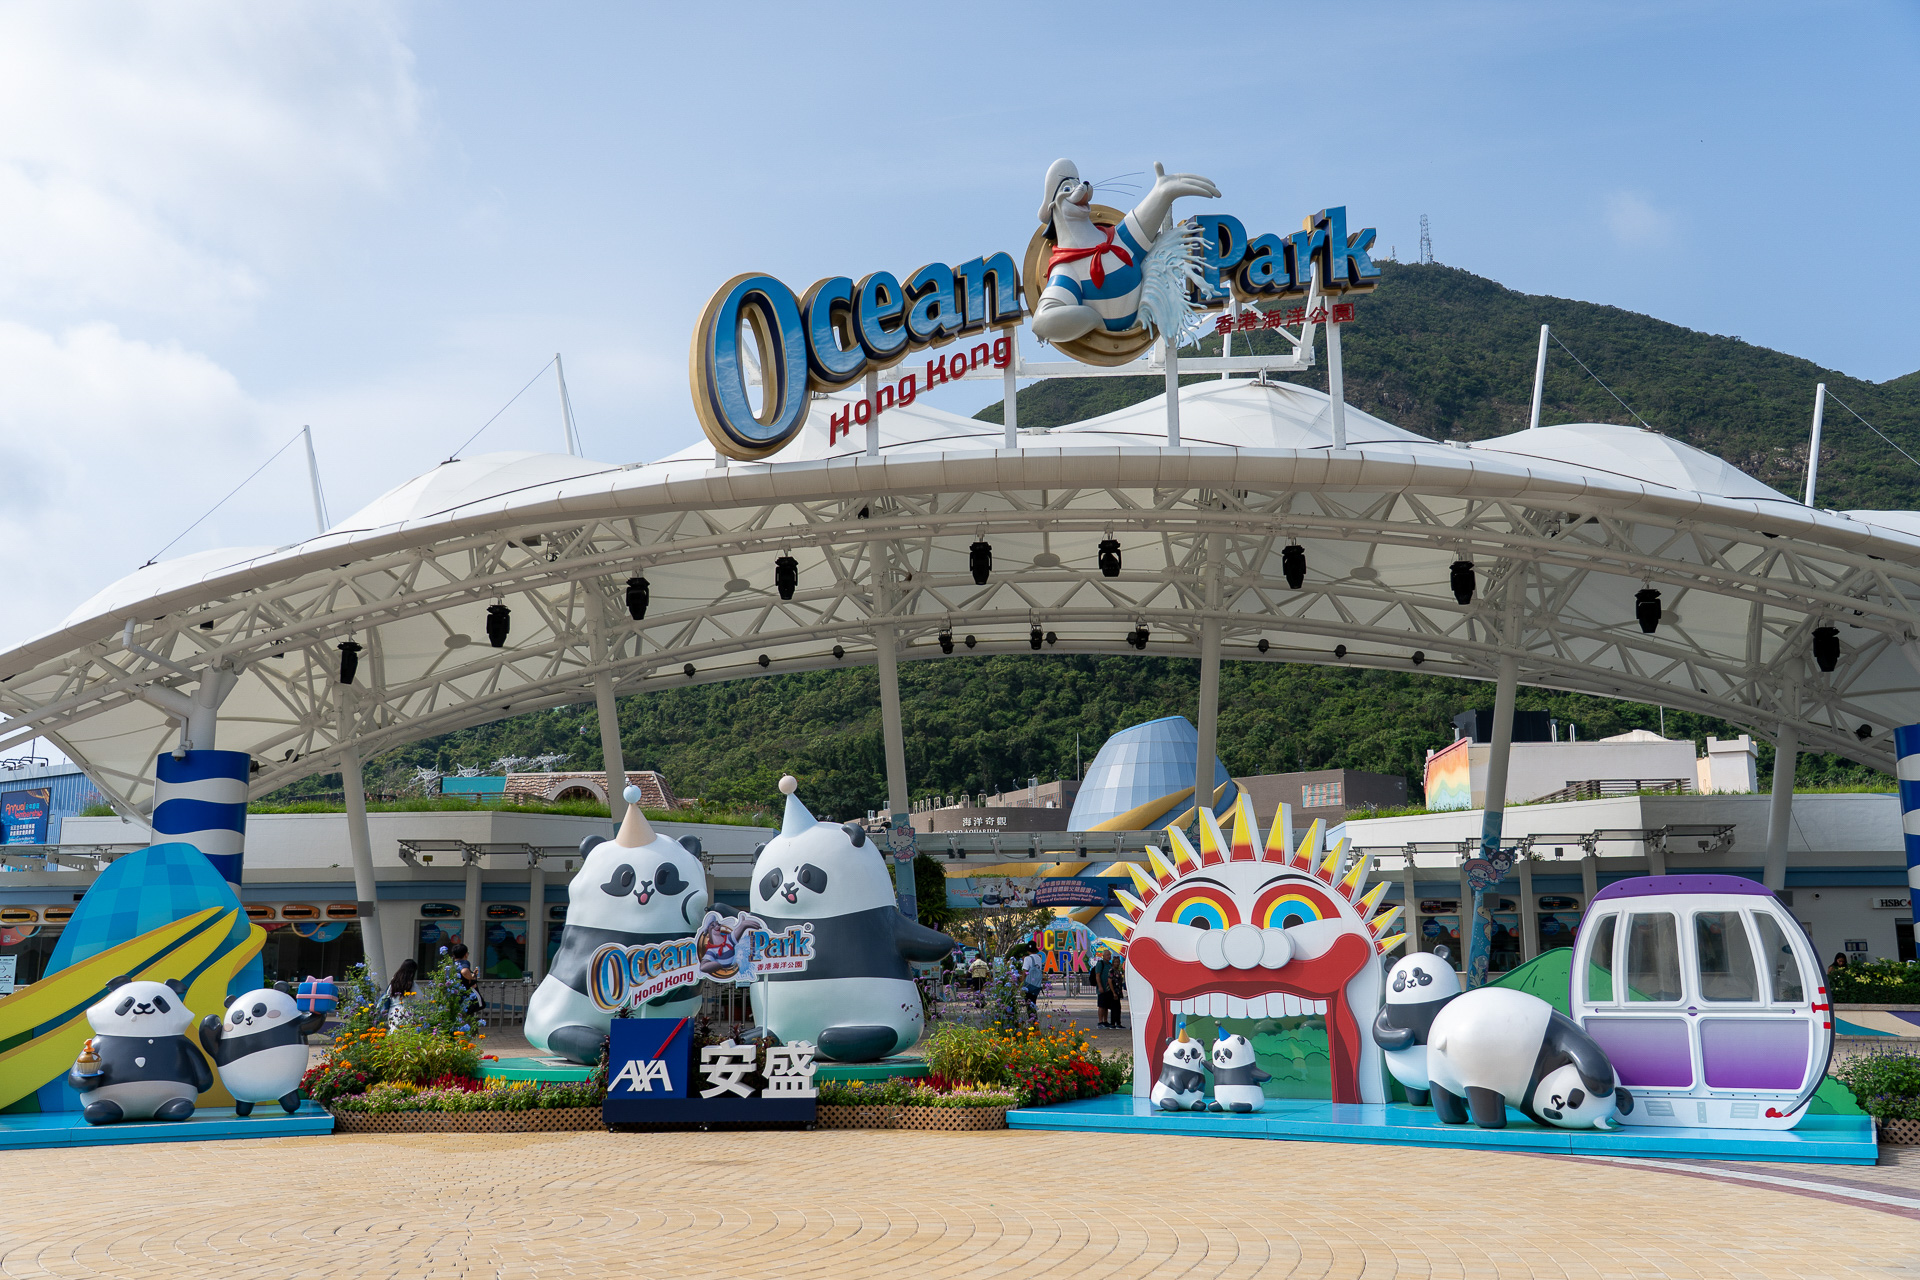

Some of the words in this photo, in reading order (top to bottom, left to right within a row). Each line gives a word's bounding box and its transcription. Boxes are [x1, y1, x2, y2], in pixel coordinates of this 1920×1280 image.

[692, 251, 1023, 459] Ocean
[1186, 206, 1381, 308] Park
[1215, 303, 1354, 336] 香港海洋公園
[830, 373, 916, 447] Hong
[926, 336, 1011, 391] Kong
[962, 816, 1008, 827] 海洋奇觀
[1880, 899, 1908, 907] HSBC
[1033, 929, 1087, 950] OCEAN
[591, 942, 697, 1008] Ocean
[749, 929, 810, 961] Park
[757, 961, 803, 971] 香港海洋公園
[634, 978, 664, 1005] Hong
[664, 971, 694, 987] Kong
[607, 1060, 673, 1092] AXA
[700, 1039, 820, 1099] 安盛
